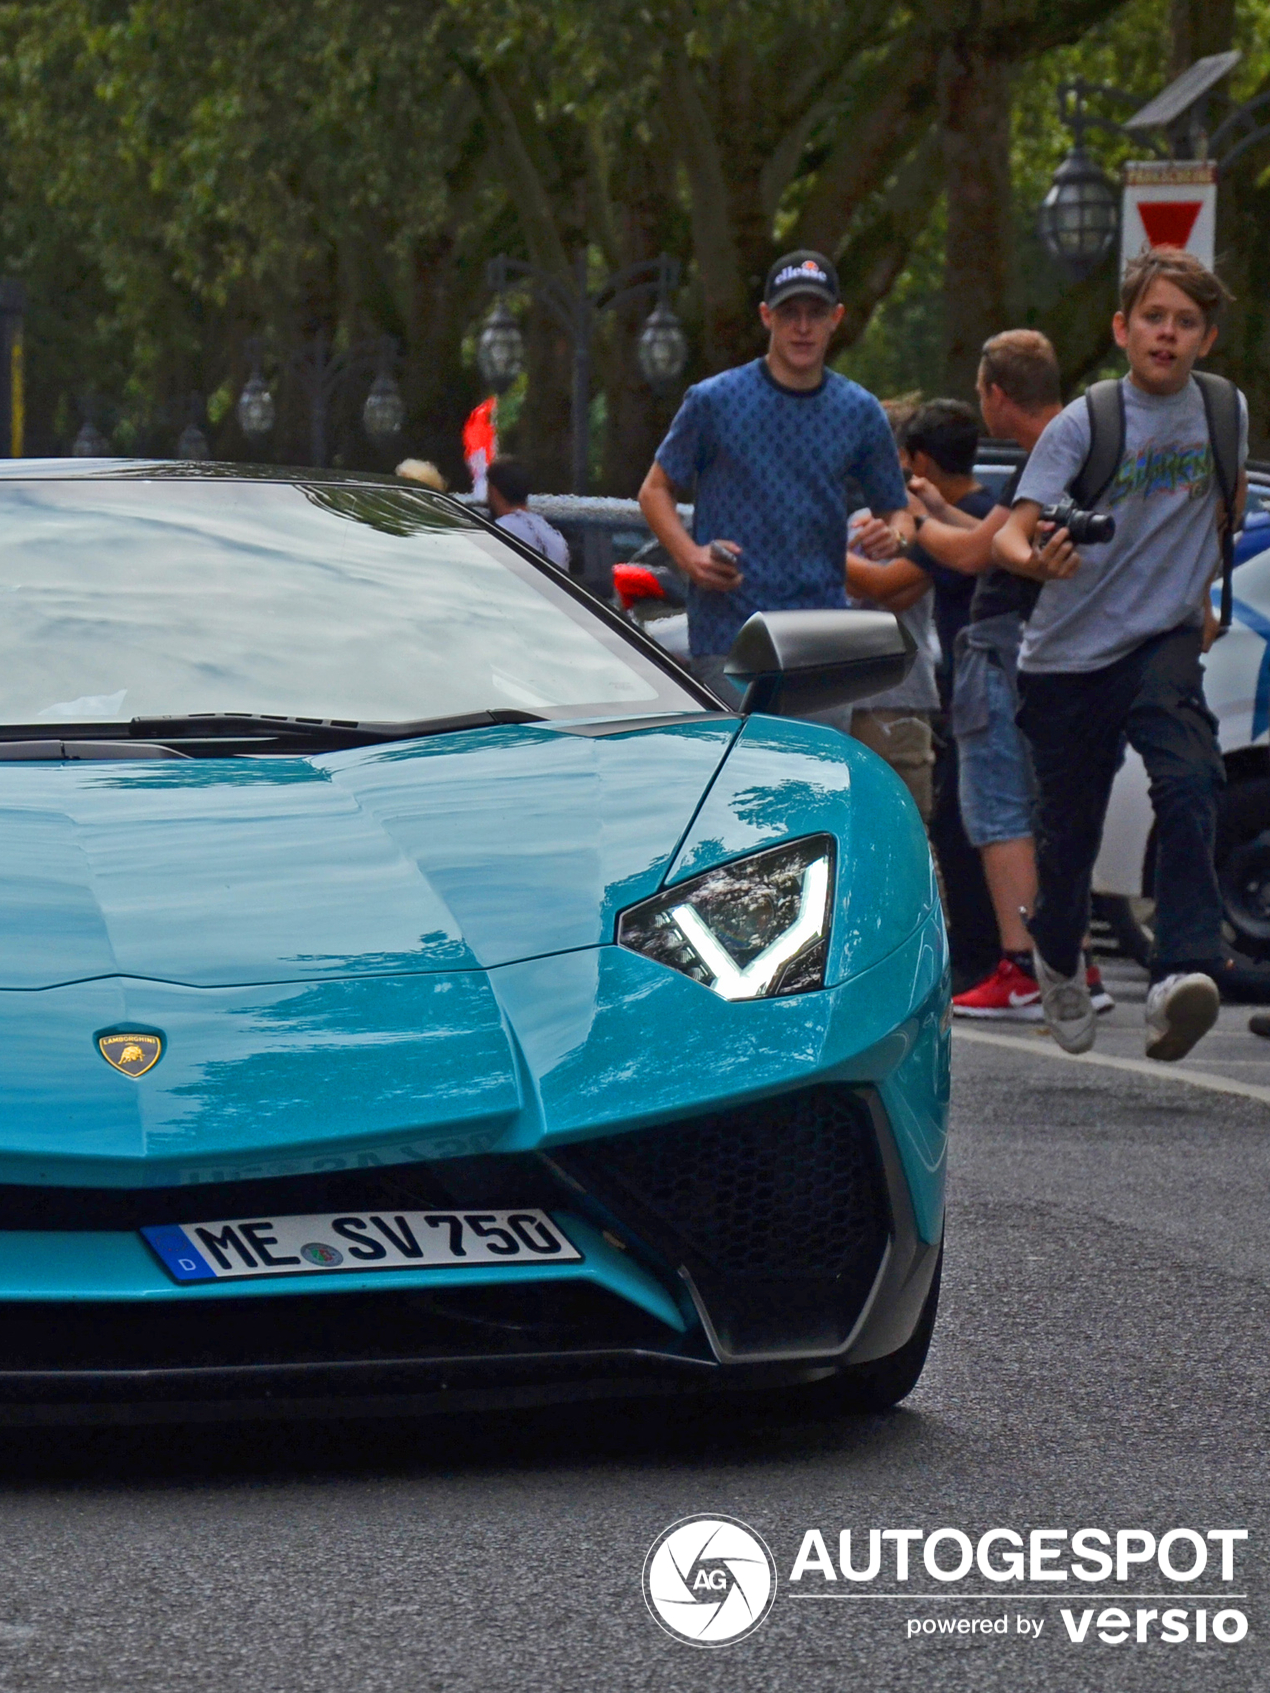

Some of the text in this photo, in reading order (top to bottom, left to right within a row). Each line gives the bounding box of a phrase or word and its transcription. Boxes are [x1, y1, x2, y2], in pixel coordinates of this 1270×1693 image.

[774, 266, 827, 285] ellesse
[103, 1036, 156, 1045] LAMBORGHINI
[178, 1213, 563, 1272] D ME SV 750
